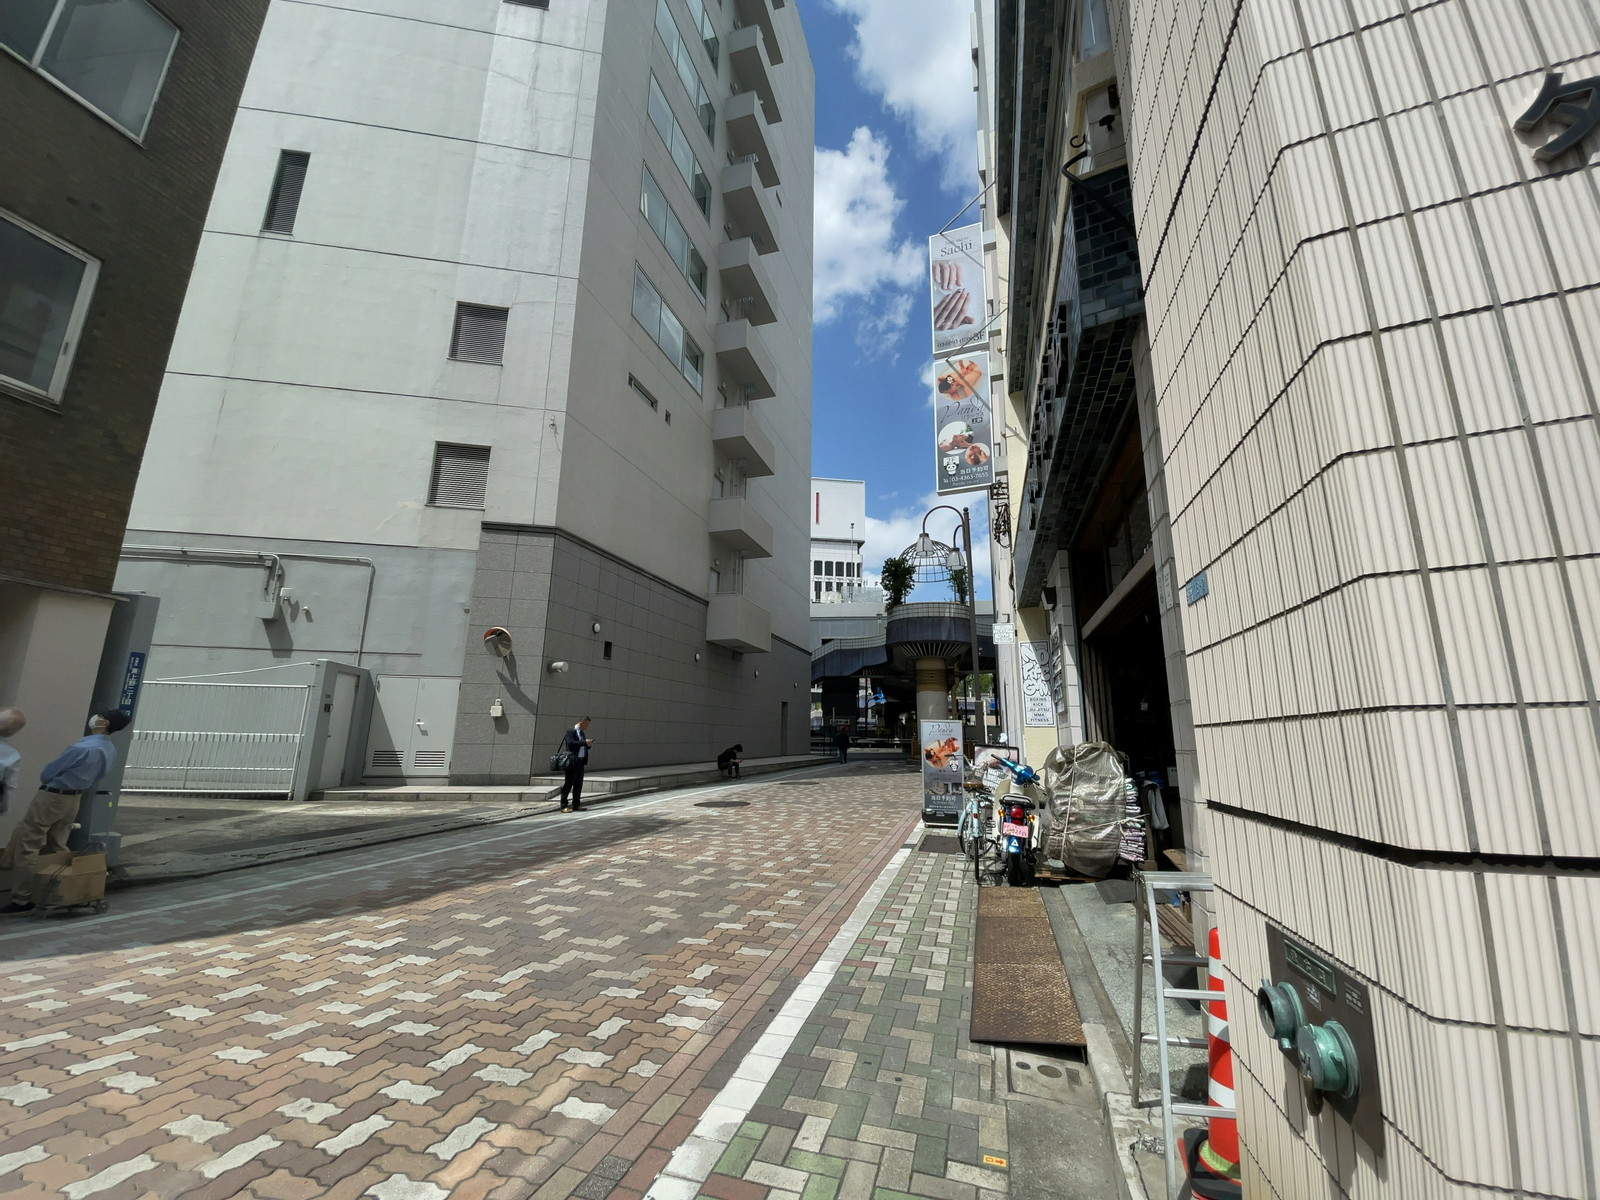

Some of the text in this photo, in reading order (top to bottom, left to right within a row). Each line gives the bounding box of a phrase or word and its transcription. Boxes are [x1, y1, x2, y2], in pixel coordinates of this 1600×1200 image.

[940, 240, 973, 257] Sachi
[960, 465, 989, 475] 当日予約可
